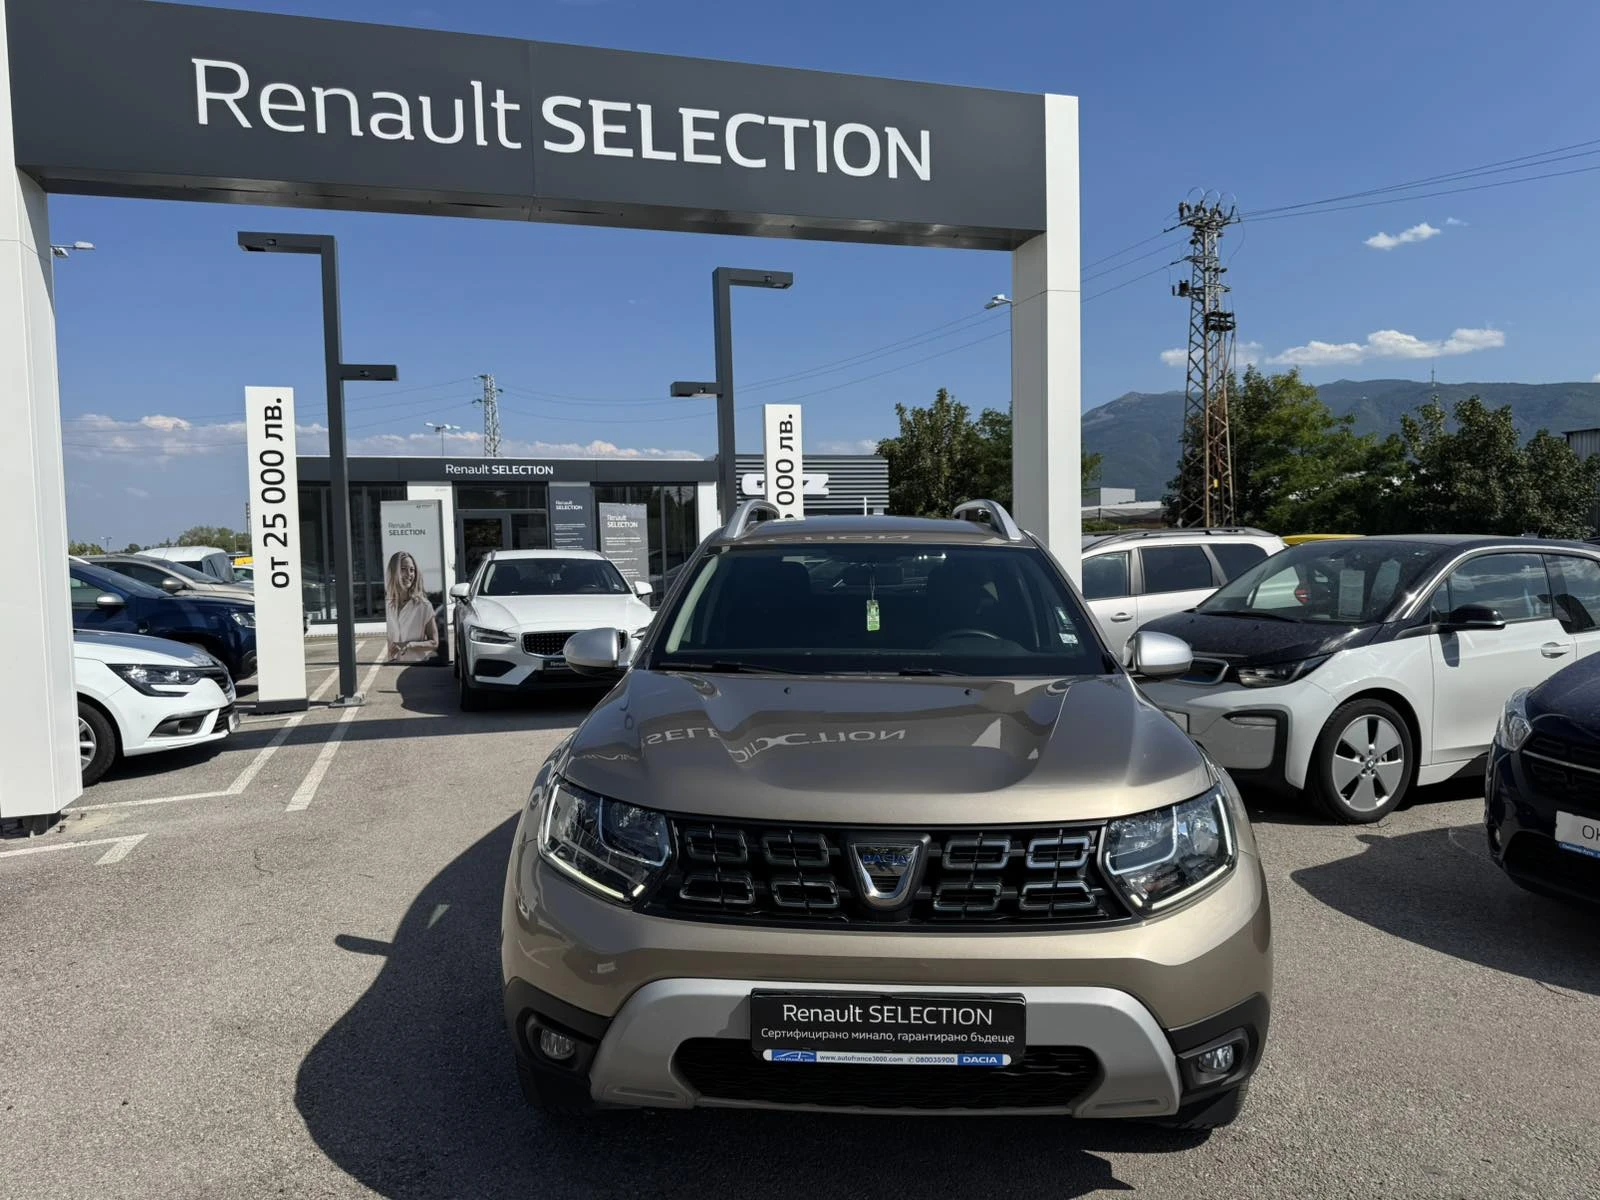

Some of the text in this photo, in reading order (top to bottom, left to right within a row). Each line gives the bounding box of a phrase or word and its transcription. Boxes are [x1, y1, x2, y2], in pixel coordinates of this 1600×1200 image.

[191, 57, 932, 183] Renault SELECTION
[779, 413, 794, 452] лв.
[445, 463, 554, 475] Renault SELECTION
[775, 458, 795, 506] 000
[259, 397, 290, 589] от 25 000 лв.
[782, 1004, 993, 1025] Renault SELECTION
[761, 1027, 1015, 1044] Сертифицирано минало, гарантирано бъдеще
[962, 1056, 998, 1064] DACIA
